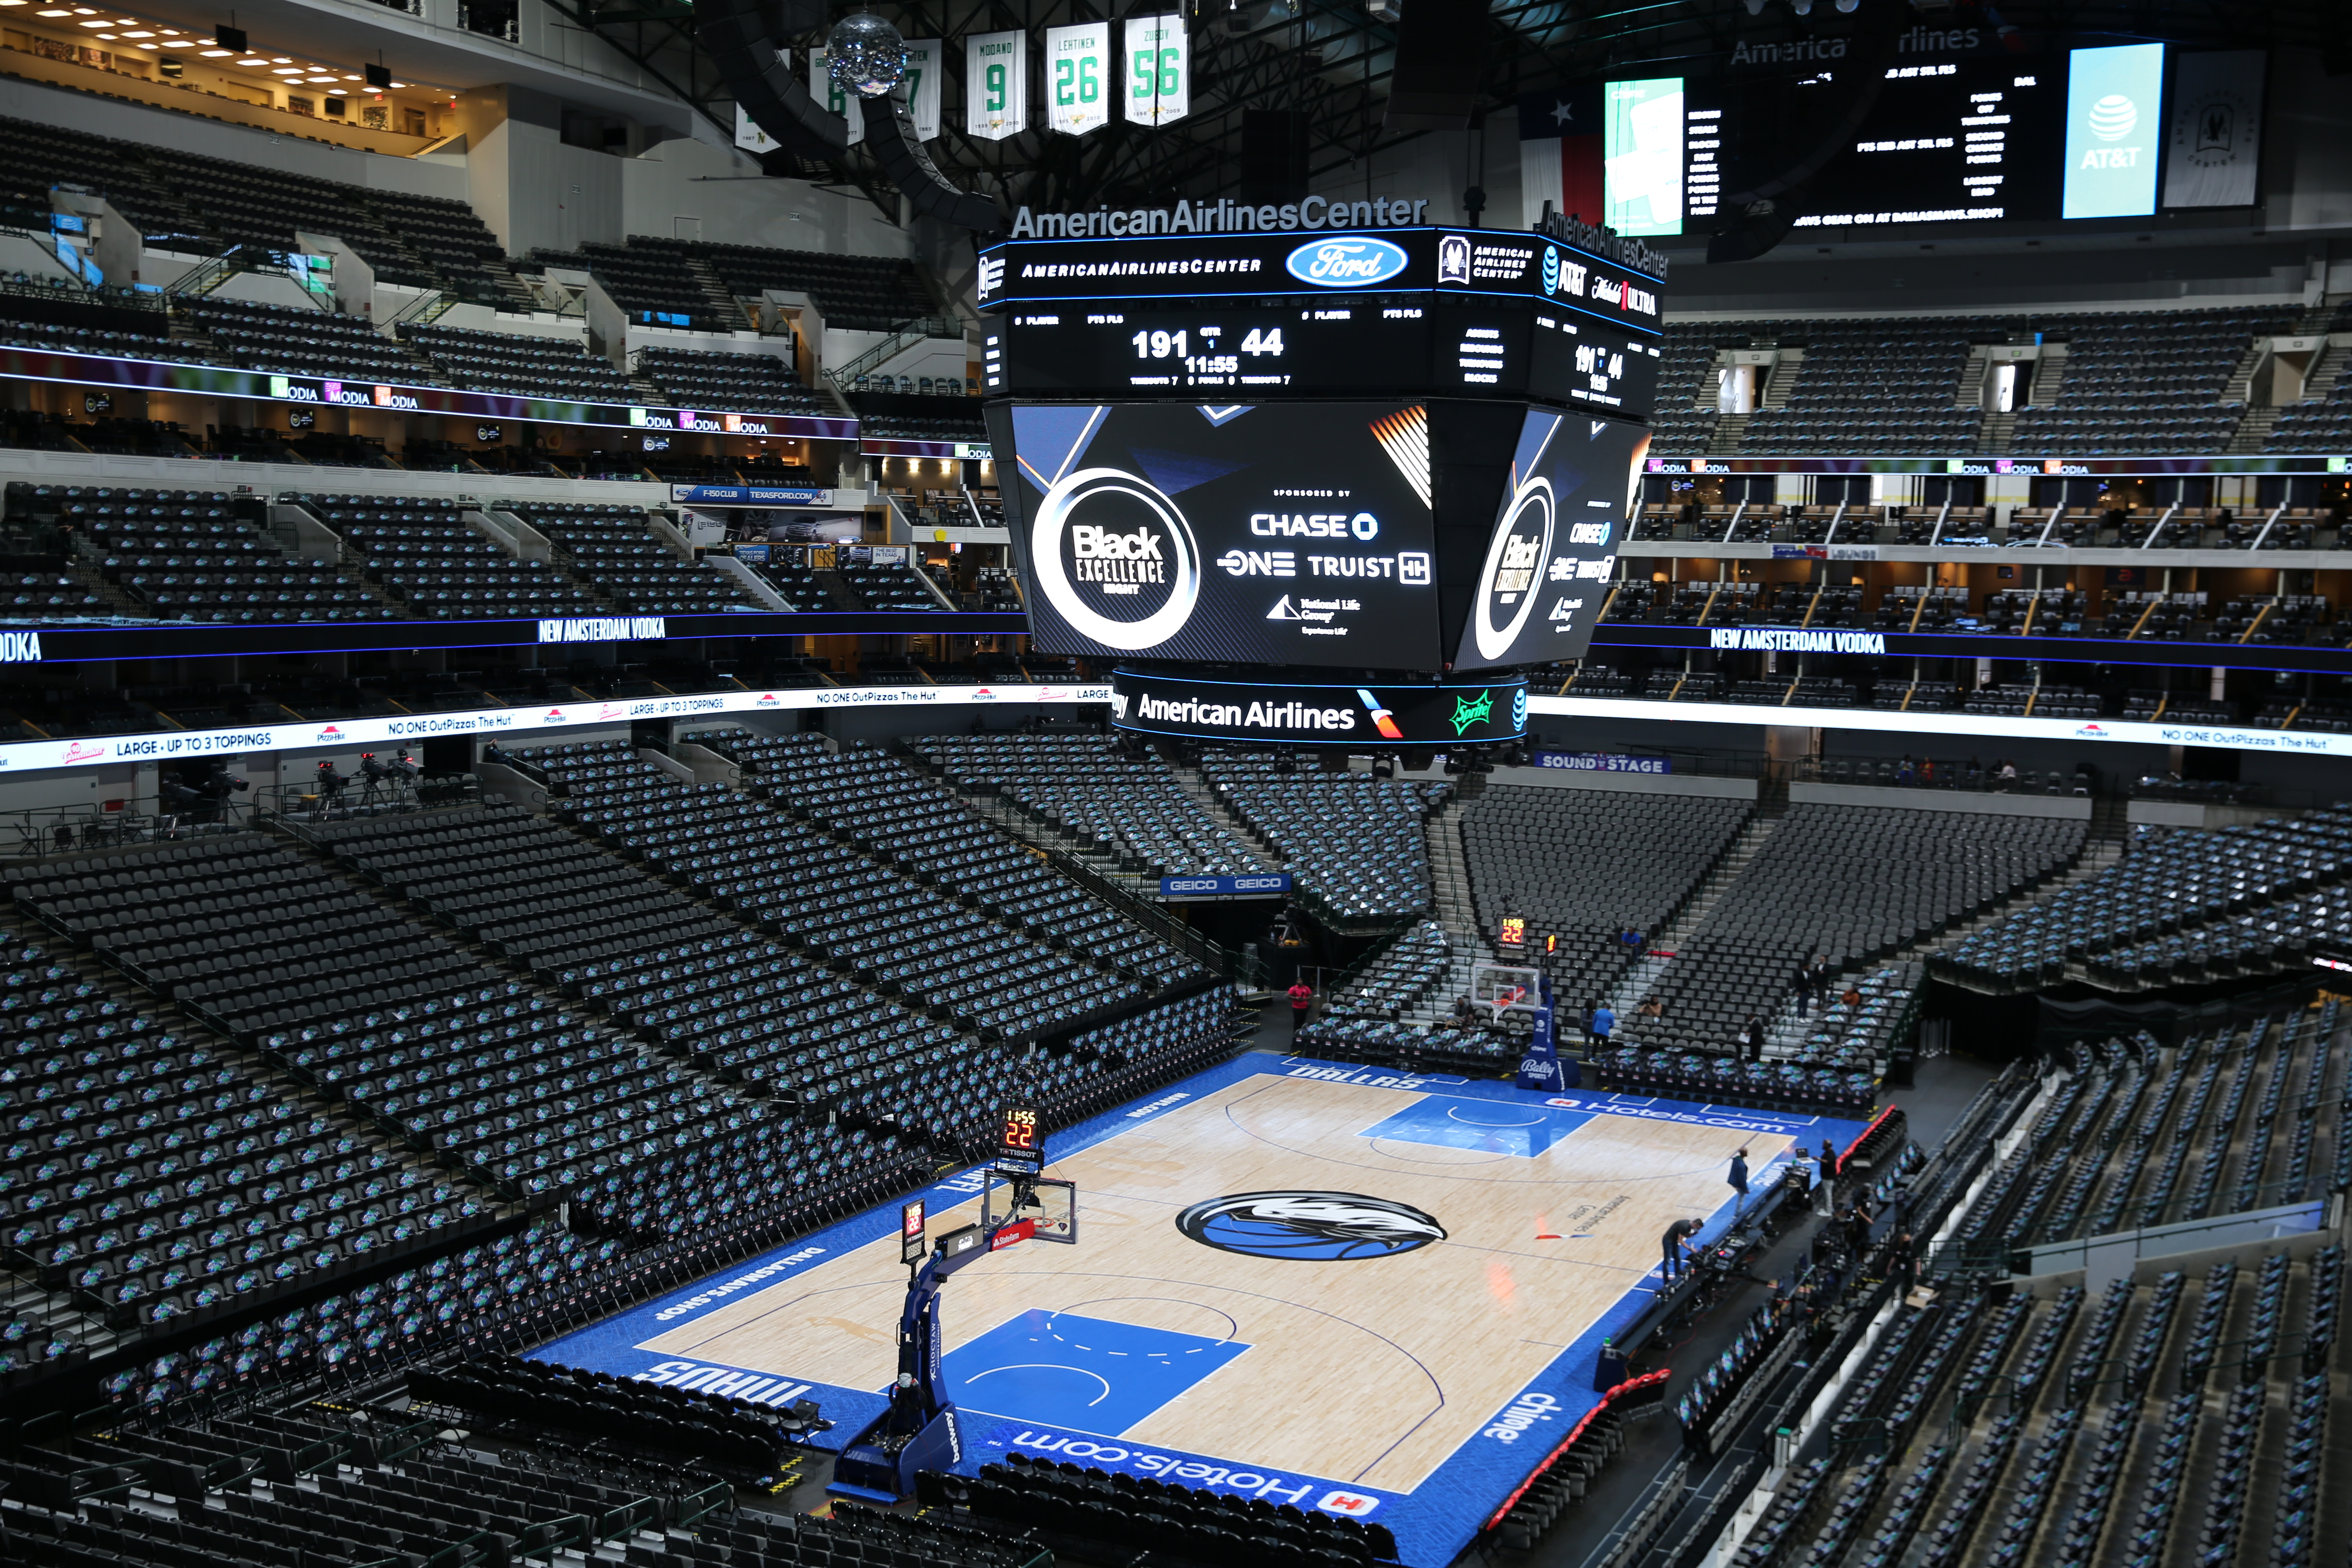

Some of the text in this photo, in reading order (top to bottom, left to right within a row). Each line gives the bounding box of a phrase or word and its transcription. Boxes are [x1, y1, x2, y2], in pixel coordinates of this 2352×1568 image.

[1058, 38, 1095, 51] LEHTINEN
[1145, 29, 1169, 42] ZUBOV
[980, 43, 1011, 56] MODANO
[1731, 36, 1851, 65] America
[1057, 56, 1098, 106] 26
[1134, 48, 1179, 98] 56
[2014, 76, 2036, 87] DAL
[905, 69, 921, 115] 7
[987, 64, 1005, 111] 9
[1611, 88, 1646, 99] chime
[1689, 125, 1718, 134] STEALS
[1694, 153, 1714, 162] FAST
[2080, 147, 2141, 170] AT&T
[1822, 214, 1852, 225] GEAR
[1854, 214, 1874, 224] ON
[1875, 213, 1891, 223] AT
[1309, 244, 1384, 278] Ford
[1474, 247, 1533, 258] AMERICAN
[1473, 256, 1526, 269] AIRLINES
[1558, 261, 1587, 296] AT&T
[1627, 287, 1656, 315] ULTRA
[1027, 316, 1105, 325] PLAYER PTS
[1315, 310, 1402, 320] PLAYER PTS
[1132, 328, 1283, 358] 191 44
[1208, 340, 1214, 349] 1
[1185, 356, 1238, 373] 11:55
[1608, 353, 1623, 379] 44
[1172, 376, 1178, 385] 7
[1283, 376, 1291, 385] 7
[276, 386, 418, 408] MODIA MODIA MODIA
[635, 416, 768, 434] MODIA MODIA MODIA
[959, 449, 992, 459] MODIA
[1653, 464, 1730, 473] MODIA MODIA
[1950, 465, 2089, 474] MODIA MODIA MODIA
[751, 492, 812, 500] TEXASFORD.COM
[1251, 514, 1348, 537] CHASE
[1072, 526, 1162, 561] Black
[1501, 535, 1540, 568] Black
[1832, 550, 1875, 560] LOUNGE
[1076, 559, 1165, 584] EXCELLENCE
[1307, 556, 1395, 577] TRUIST
[1103, 584, 1140, 595] NIGHT
[1300, 599, 1361, 610] National Life
[1301, 611, 1333, 623] Group
[539, 620, 563, 643] NEW
[632, 617, 666, 639] VODKA
[1711, 628, 1741, 649] NEW
[1835, 633, 1885, 654] VODKA
[817, 691, 936, 703] NO ONE OutPizzas The Hut
[1077, 690, 1108, 699] LARGE
[630, 699, 724, 716] LARGE UP TO 3 TOPPINGS
[1138, 694, 1241, 725] American
[1245, 702, 1355, 729] Airlines
[1456, 703, 1488, 723] Sprite
[389, 714, 512, 735] NO ONE OutPizzas The Hut
[117, 733, 271, 756] LARGE UP TO 3 TOPPINGS
[2162, 730, 2327, 749] NO ONE OutPizzas The Hut
[1543, 755, 1597, 769] SOUND
[1607, 759, 1663, 773] STAGE
[1170, 878, 1282, 891] GEICO GEICO
[1502, 926, 1522, 943] 22
[1521, 1059, 1555, 1077] Bally
[1286, 1066, 1426, 1090] DALLAS
[1125, 1092, 1192, 1118] MAVS.COM
[1008, 1110, 1036, 1125] 11:55
[1586, 1102, 1786, 1133] Hotels.com
[1006, 1123, 1031, 1147] 22
[1009, 1149, 1036, 1158] TISSOT
[908, 1218, 919, 1232] 22
[911, 1232, 924, 1241] TISSOT
[655, 1246, 826, 1322] DALLASMAVS.SHOP
[1483, 1392, 1563, 1442] chime
[945, 1412, 960, 1463] betway
[1013, 1429, 1314, 1503] Hotels.com
